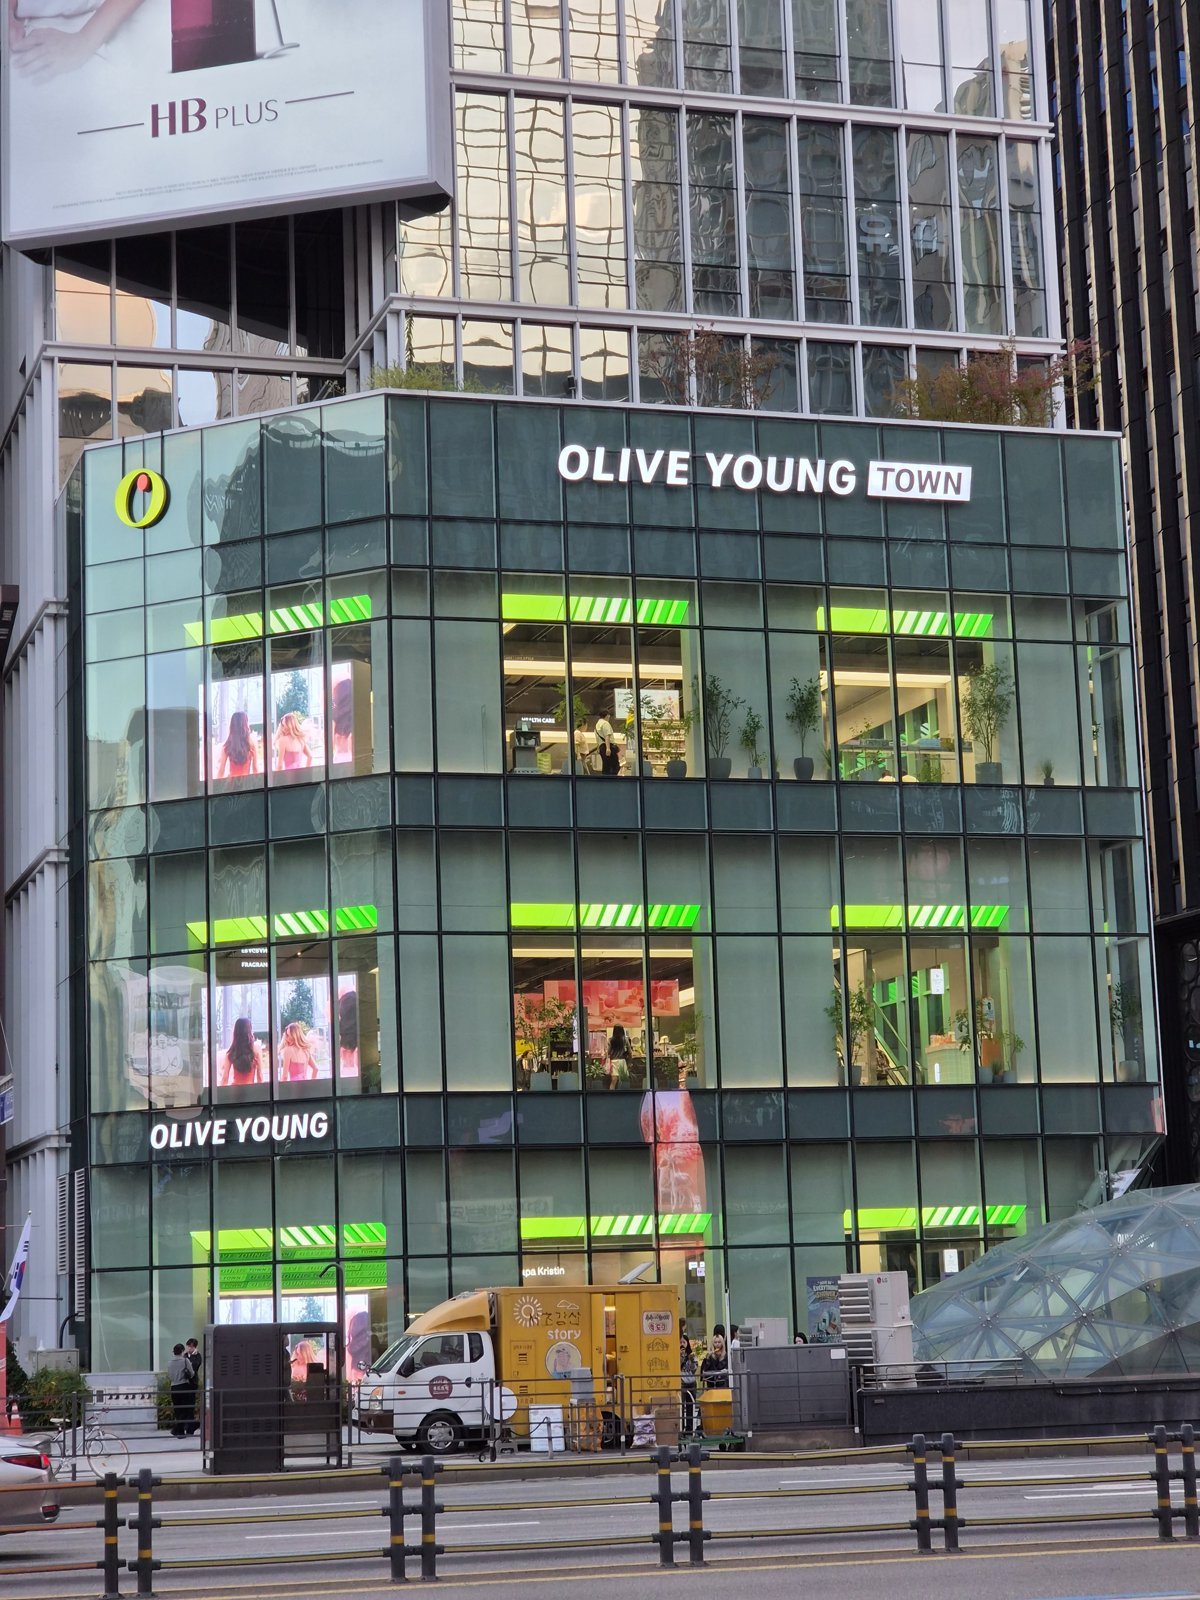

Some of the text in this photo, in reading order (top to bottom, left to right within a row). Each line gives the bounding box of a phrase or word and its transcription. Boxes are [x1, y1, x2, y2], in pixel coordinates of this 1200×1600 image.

[151, 97, 279, 138] HB PLUS
[558, 444, 963, 496] OLIVE YOUNG TOWN
[150, 1112, 328, 1149] OLIVE YOUNG
[537, 1266, 565, 1276] Kristin
[547, 1328, 581, 1340] story
